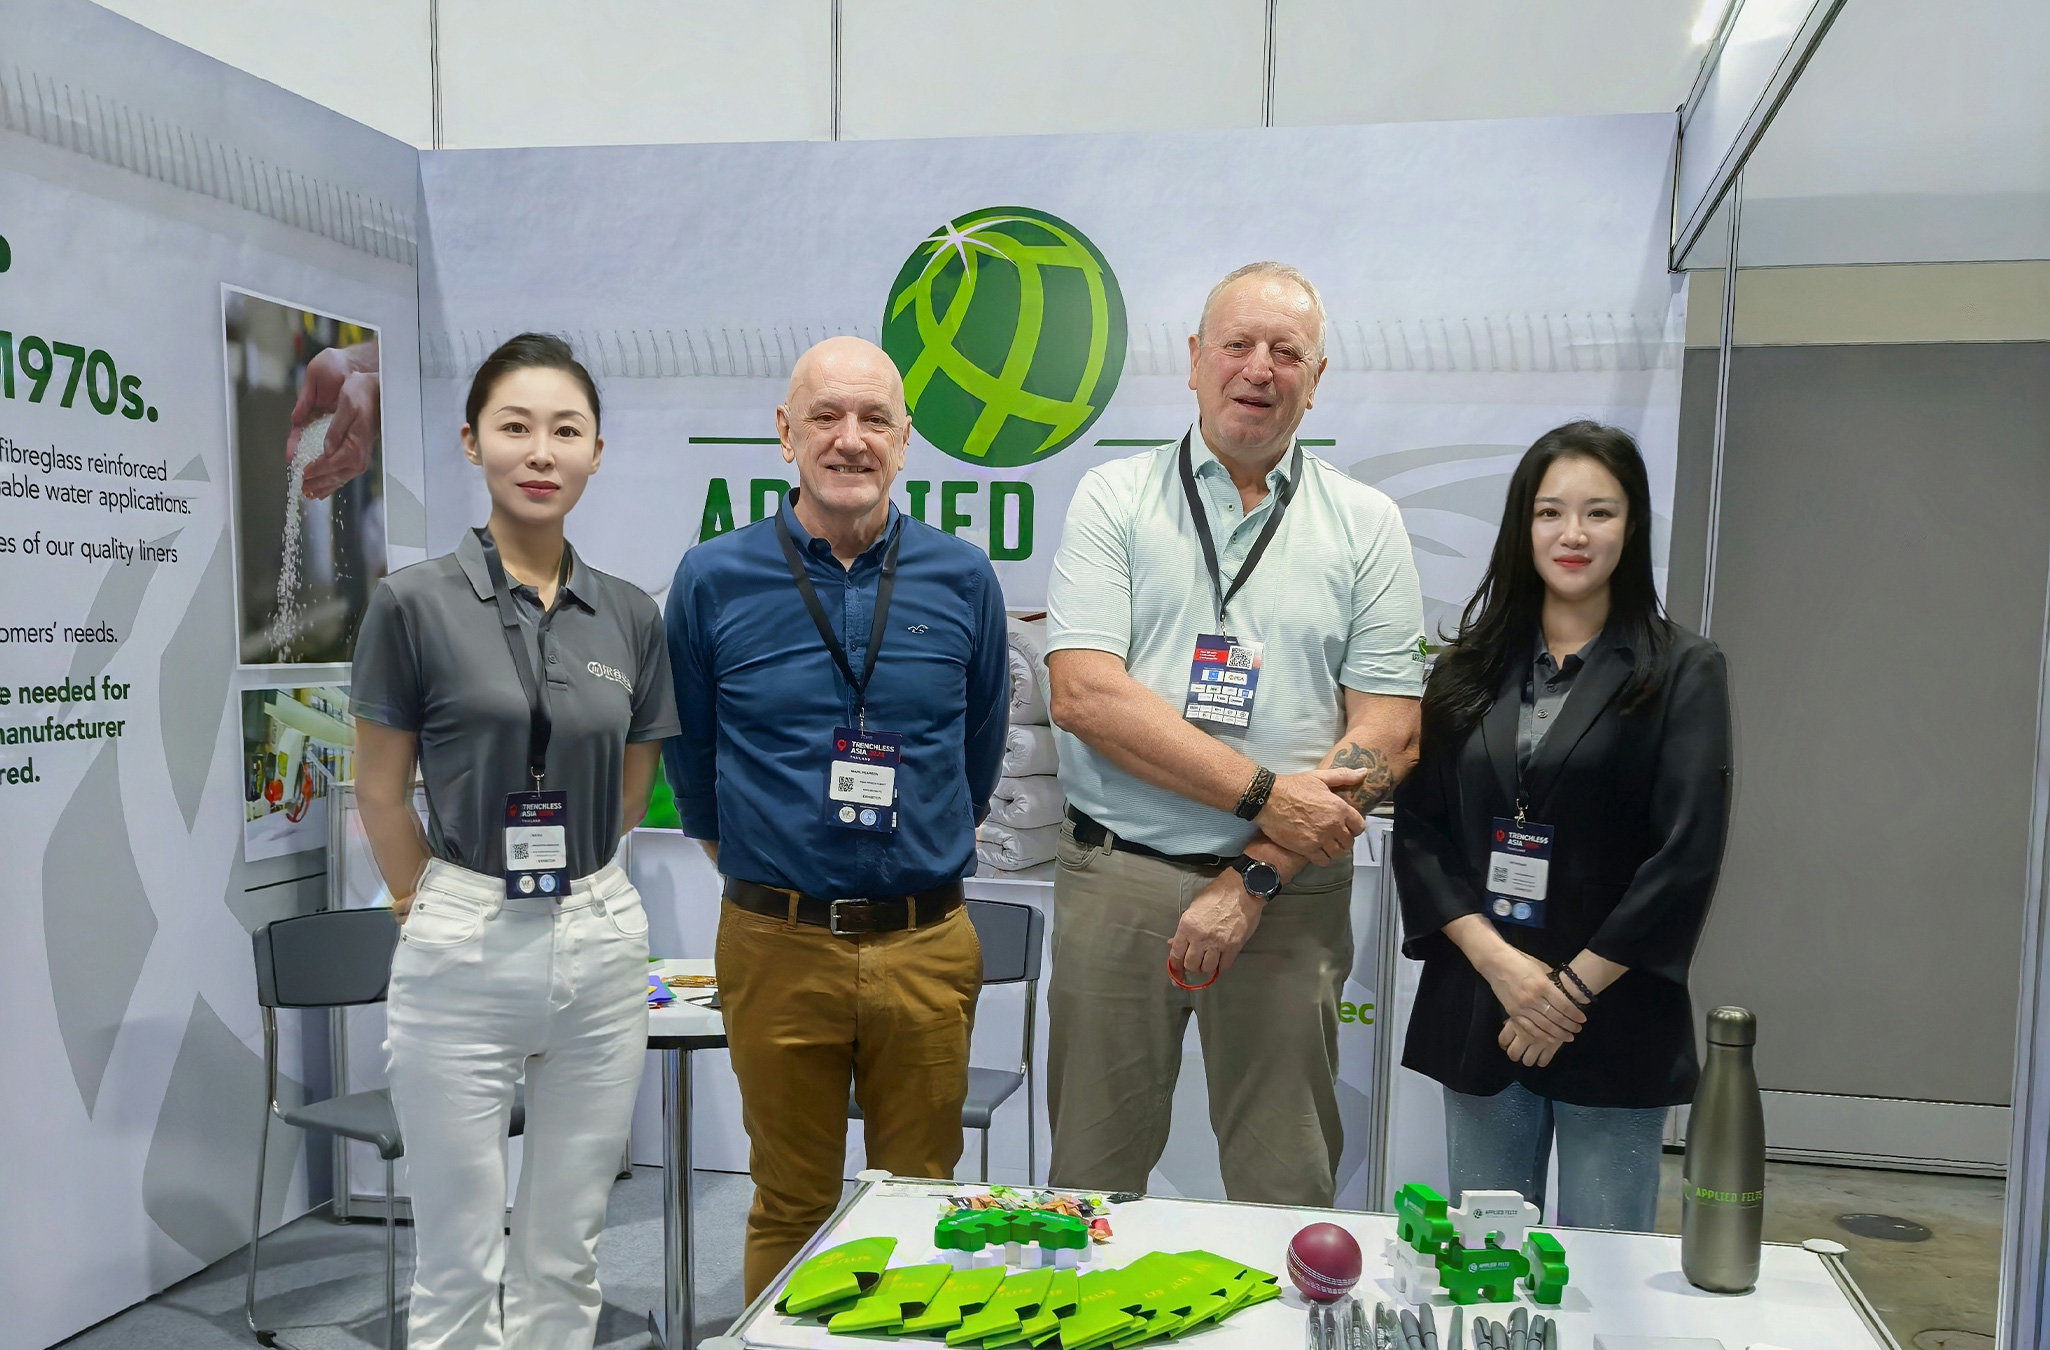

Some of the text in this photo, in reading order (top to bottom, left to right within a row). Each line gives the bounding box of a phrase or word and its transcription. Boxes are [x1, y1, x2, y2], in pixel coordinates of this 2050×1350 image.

[0, 330, 159, 423] 1970s.
[0, 436, 167, 481] fibreglass reinforced
[0, 473, 191, 515] able water applications.
[23, 530, 41, 555] of
[46, 540, 75, 556] our
[81, 536, 134, 567] quality
[139, 538, 178, 563] liners
[64, 620, 118, 643] needs.
[19, 676, 96, 704] needed
[102, 675, 131, 700] for
[850, 747, 868, 756] ASIA
[851, 740, 895, 753] TRENCHLESS
[522, 802, 562, 810] TRENCHLESS
[1507, 838, 1523, 846] ASIA
[1508, 831, 1549, 845] TRENCHLESS
[1696, 1187, 1737, 1203] APPLIED
